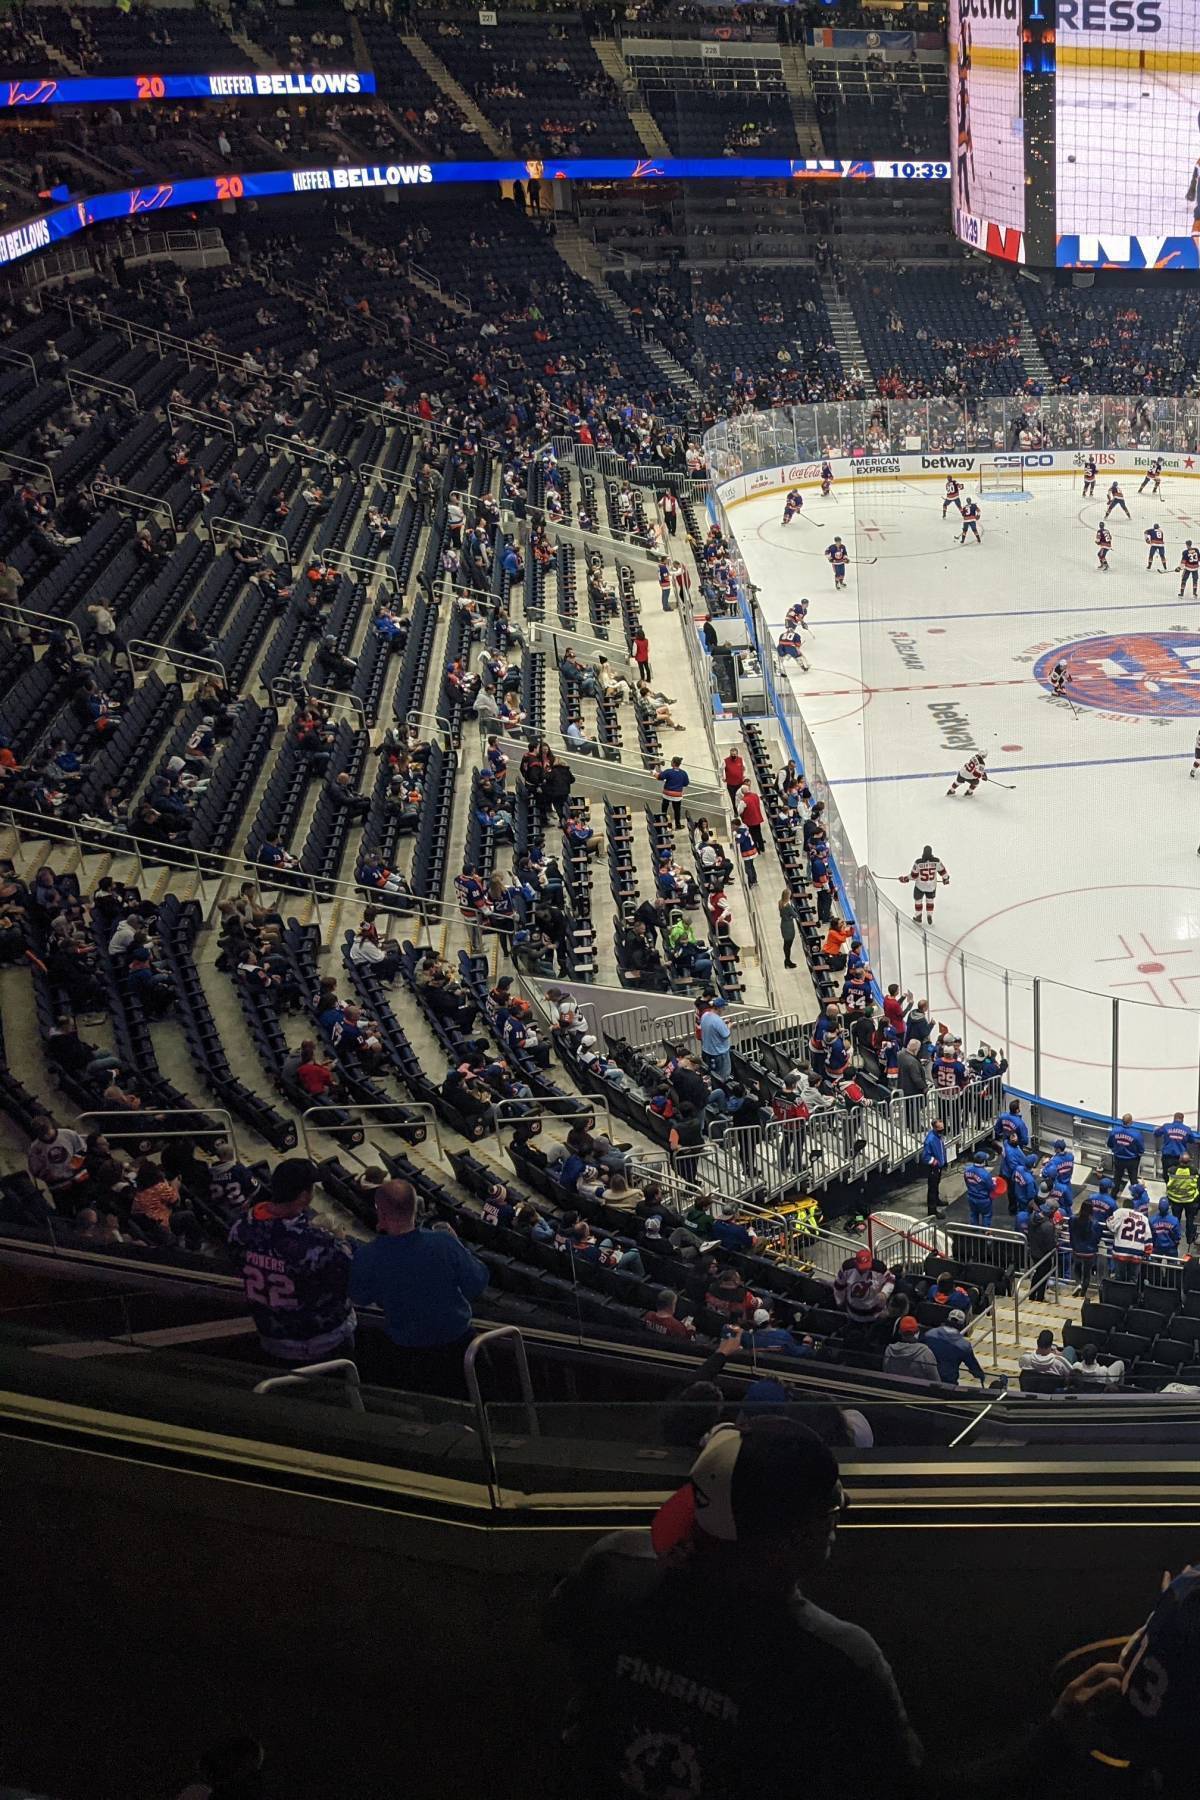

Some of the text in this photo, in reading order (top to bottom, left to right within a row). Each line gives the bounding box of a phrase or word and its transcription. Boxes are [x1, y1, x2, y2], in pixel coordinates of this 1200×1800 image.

[137, 73, 361, 98] 20 KIEFFER BELLOWS
[215, 165, 433, 200] 20 KIEFFER BELLOWS
[890, 163, 948, 178] 10:39
[8, 218, 51, 260] BELLOWS
[850, 457, 900, 468] AMERICAN
[856, 465, 901, 475] EXPRESS
[921, 456, 976, 472] betway
[928, 701, 980, 752] betway
[919, 867, 936, 882] 55
[845, 994, 866, 1010] 44
[937, 1071, 957, 1087] 29
[1120, 1217, 1147, 1241] 22
[245, 1250, 287, 1274] POWERS
[242, 1265, 299, 1308] 22
[615, 1653, 739, 1725] FINISHER
